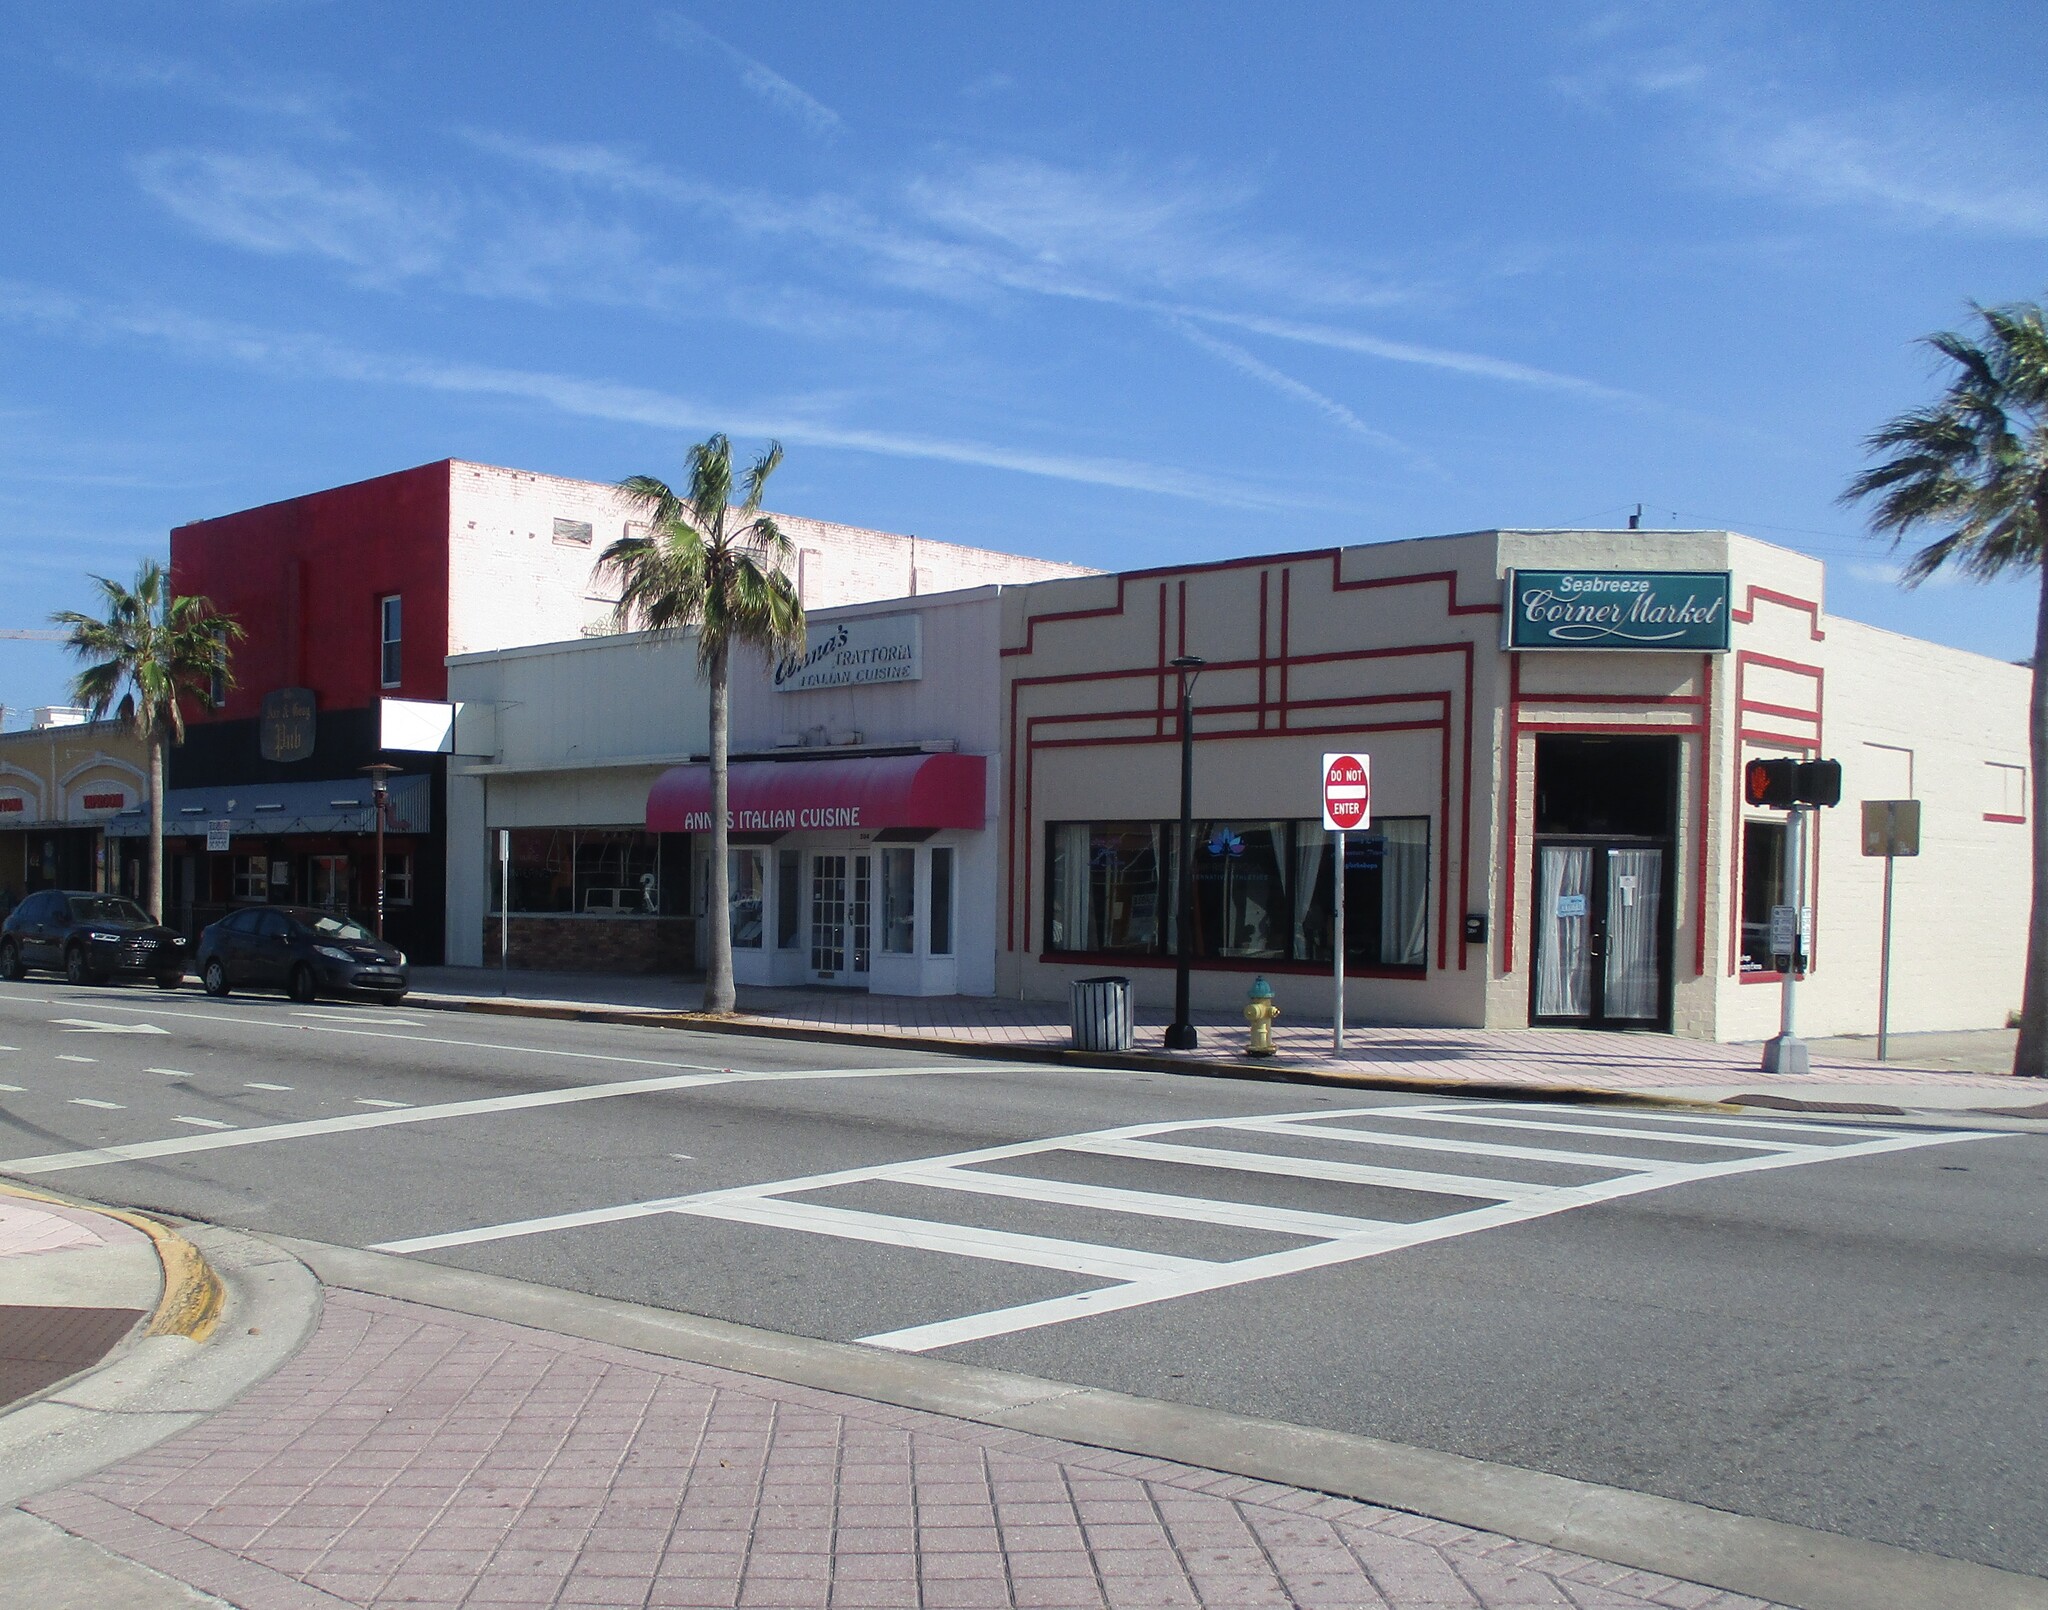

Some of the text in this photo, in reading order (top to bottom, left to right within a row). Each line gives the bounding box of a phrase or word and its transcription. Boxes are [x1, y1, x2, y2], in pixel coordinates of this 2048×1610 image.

[1560, 576, 1650, 593] Seabreeze
[1521, 589, 1724, 625] Corner Market
[835, 644, 913, 666] TRATTORIA
[800, 665, 911, 687] ITALIAN CUISINE
[1330, 769, 1362, 782] DO NOT
[739, 809, 796, 829] ITALIAN
[800, 806, 860, 828] CUISINE
[1333, 802, 1360, 815] ENTER
